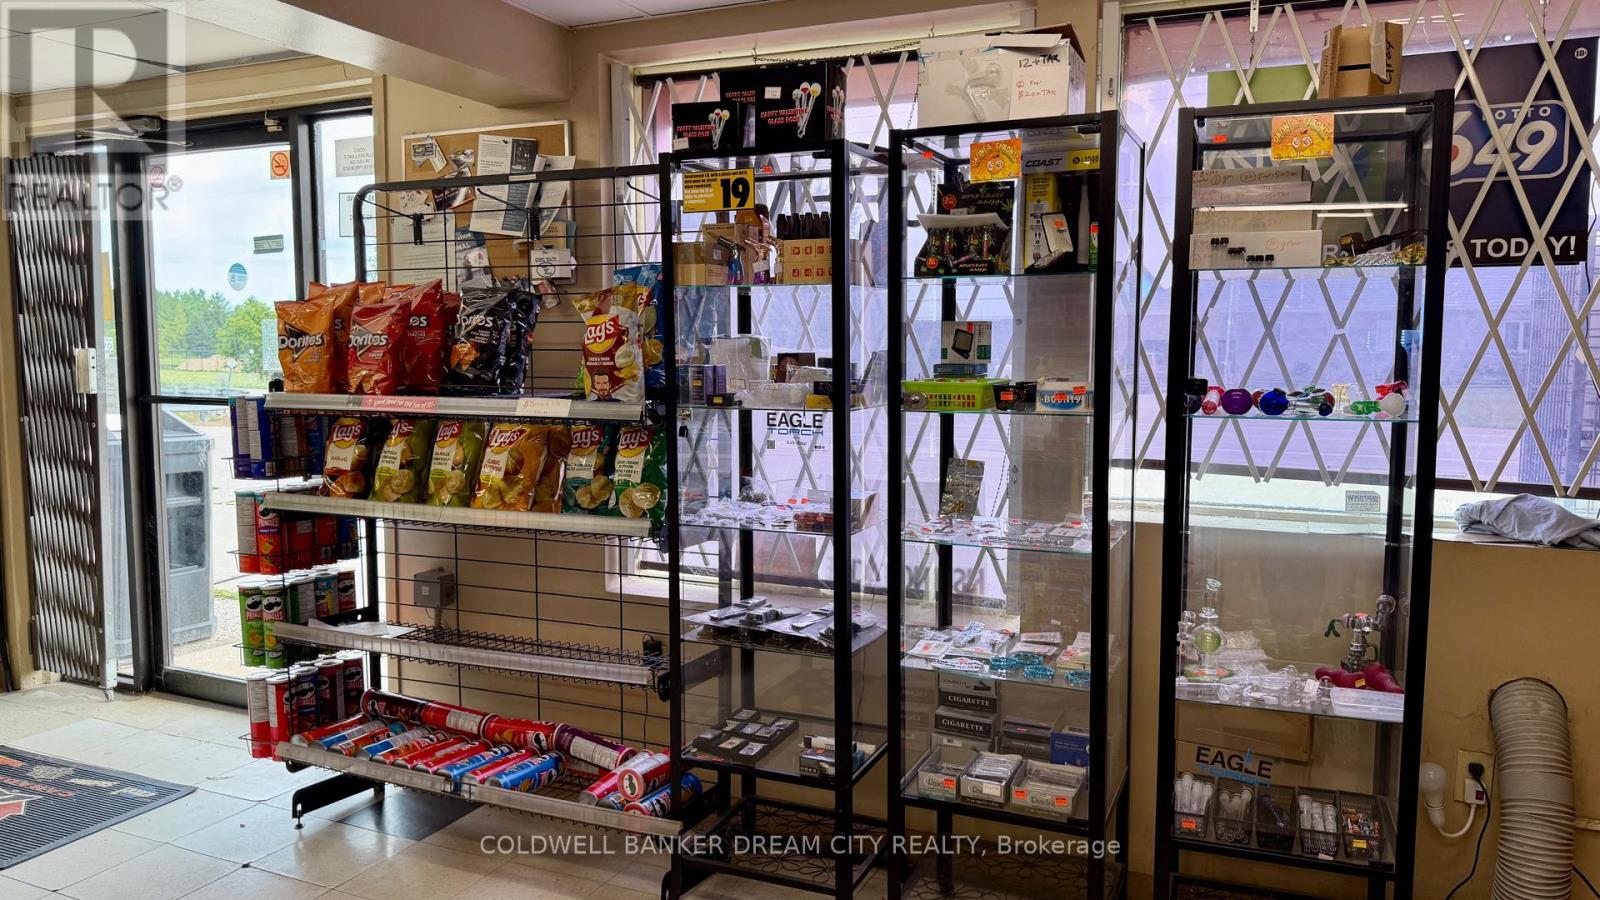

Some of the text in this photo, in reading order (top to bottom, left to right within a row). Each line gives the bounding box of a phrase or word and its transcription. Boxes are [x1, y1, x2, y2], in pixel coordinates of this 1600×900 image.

[1025, 158, 1063, 168] COAST
[720, 177, 750, 208] 19
[1470, 235, 1577, 259] TODY!
[279, 332, 323, 349] Doritos
[767, 412, 823, 428] EAGLE
[333, 423, 362, 442] Lay's
[436, 422, 459, 441] Lay's
[948, 695, 990, 706] CIGARETTE
[942, 718, 985, 732] CIGARETTE
[1195, 745, 1273, 779] EAGLE
